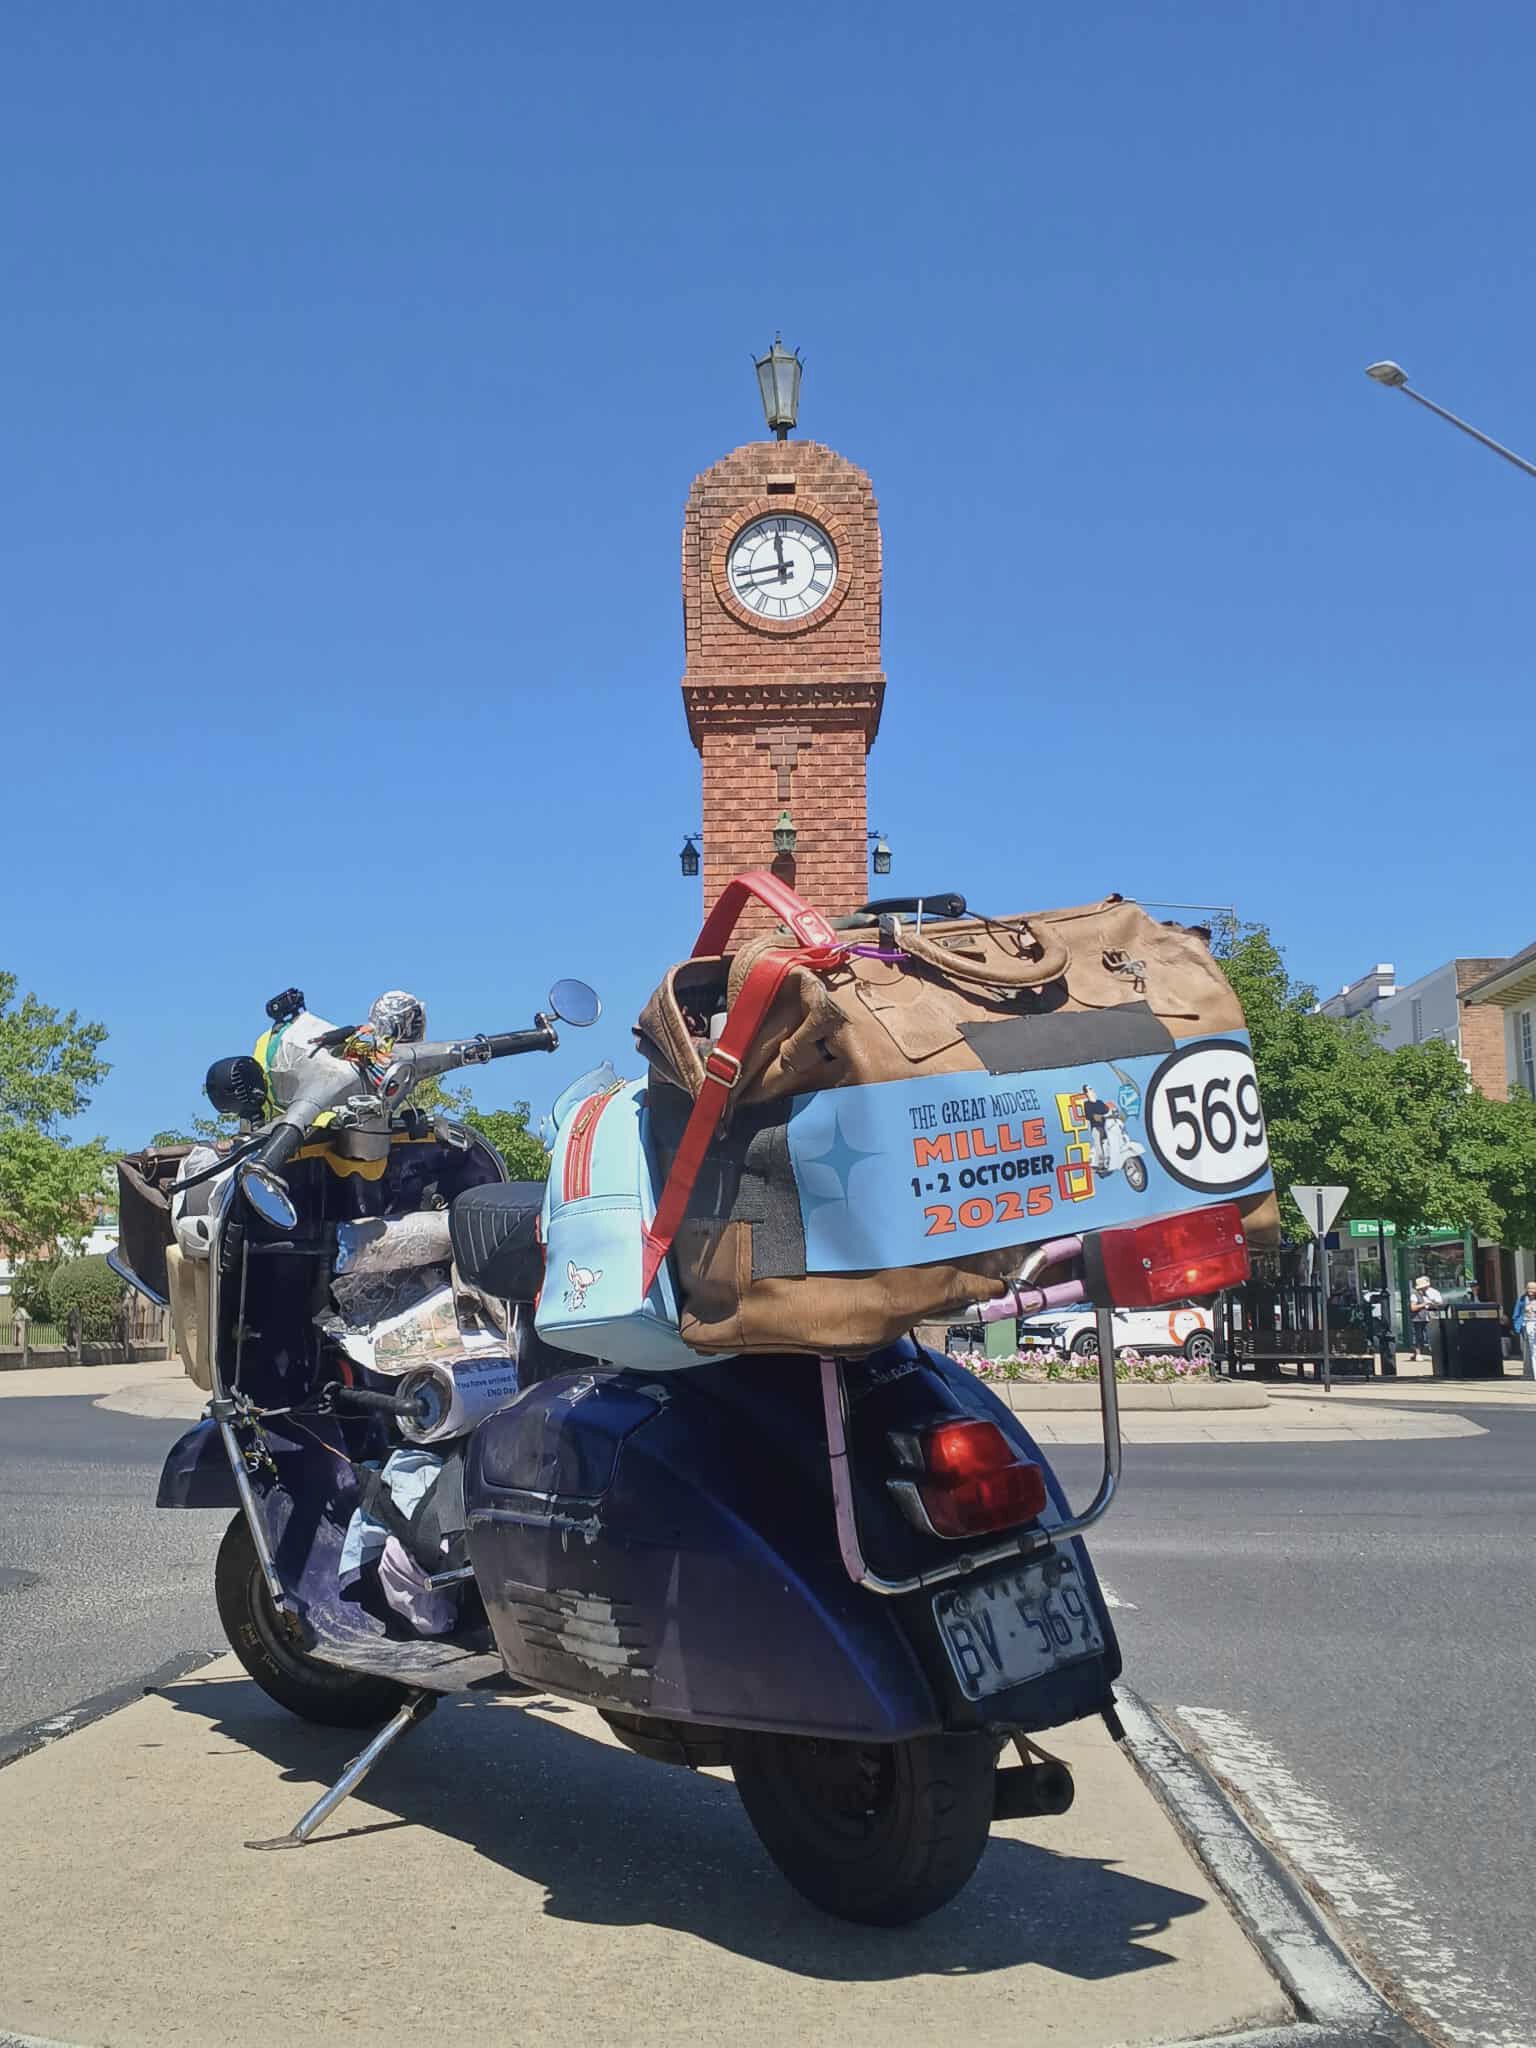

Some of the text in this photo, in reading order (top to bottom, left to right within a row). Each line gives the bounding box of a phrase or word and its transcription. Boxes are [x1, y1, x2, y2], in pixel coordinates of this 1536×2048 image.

[909, 1089, 1041, 1129] THE GREAT MUDGEE
[1165, 1074, 1264, 1161] 569
[913, 1117, 1047, 1167] MILLE
[959, 1154, 1055, 1188] OCTOBER
[924, 1185, 1053, 1237] 2025
